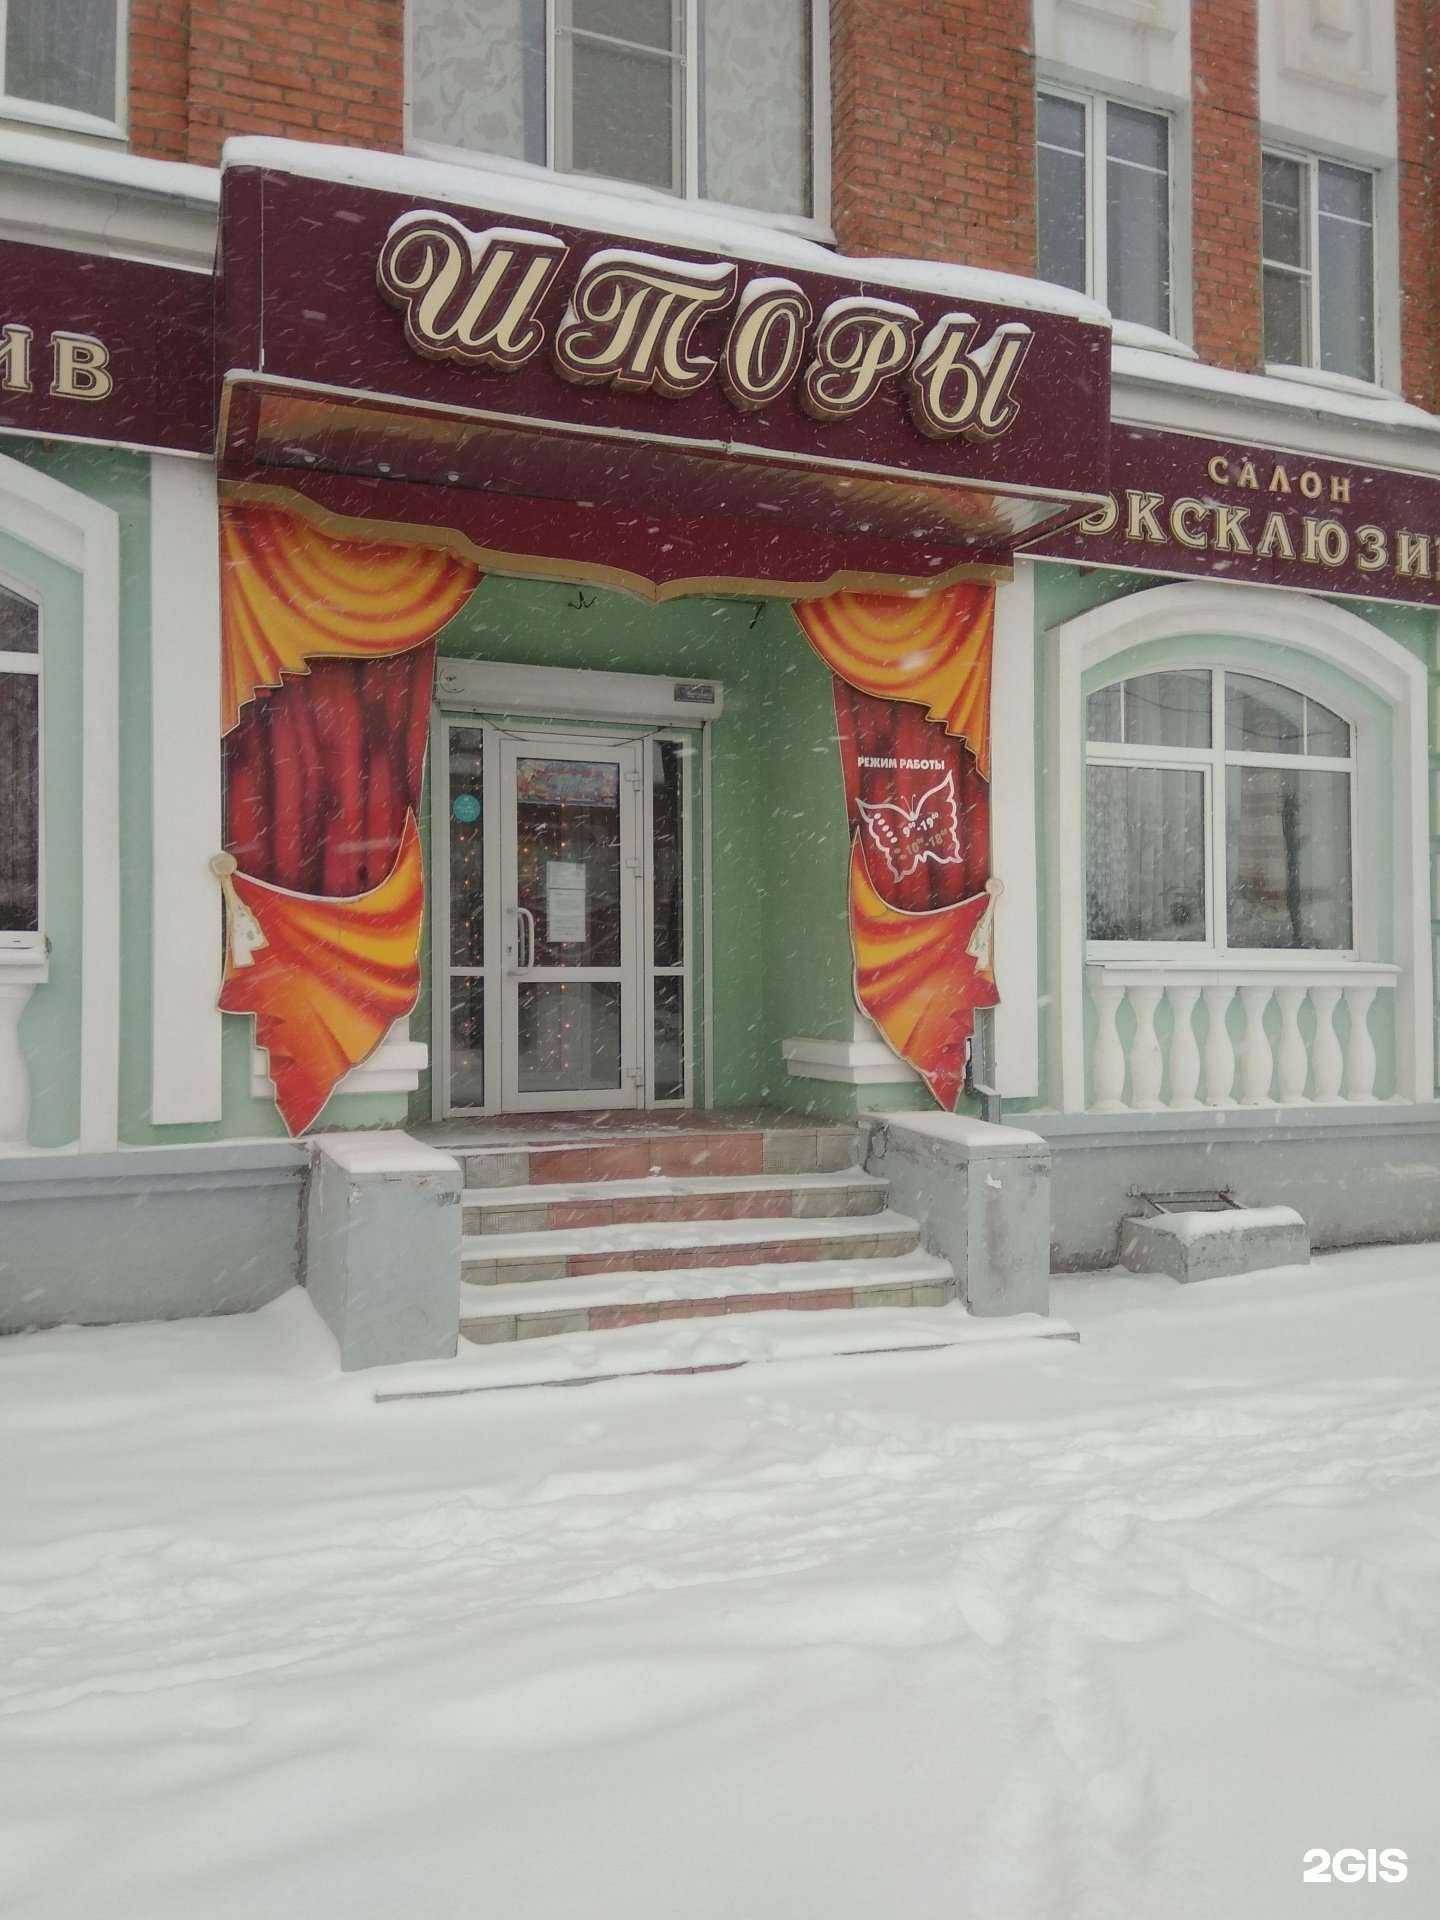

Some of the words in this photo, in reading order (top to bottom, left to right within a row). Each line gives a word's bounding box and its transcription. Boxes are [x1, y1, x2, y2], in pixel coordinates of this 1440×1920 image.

[378, 217, 1033, 440] ШТОРЫ
[1207, 456, 1351, 503] САЛОН
[1079, 490, 1440, 580] ЭКСКЛЮЗИ
[857, 756, 898, 769] РЕЖИМ
[899, 759, 945, 771] РАБОТЫ
